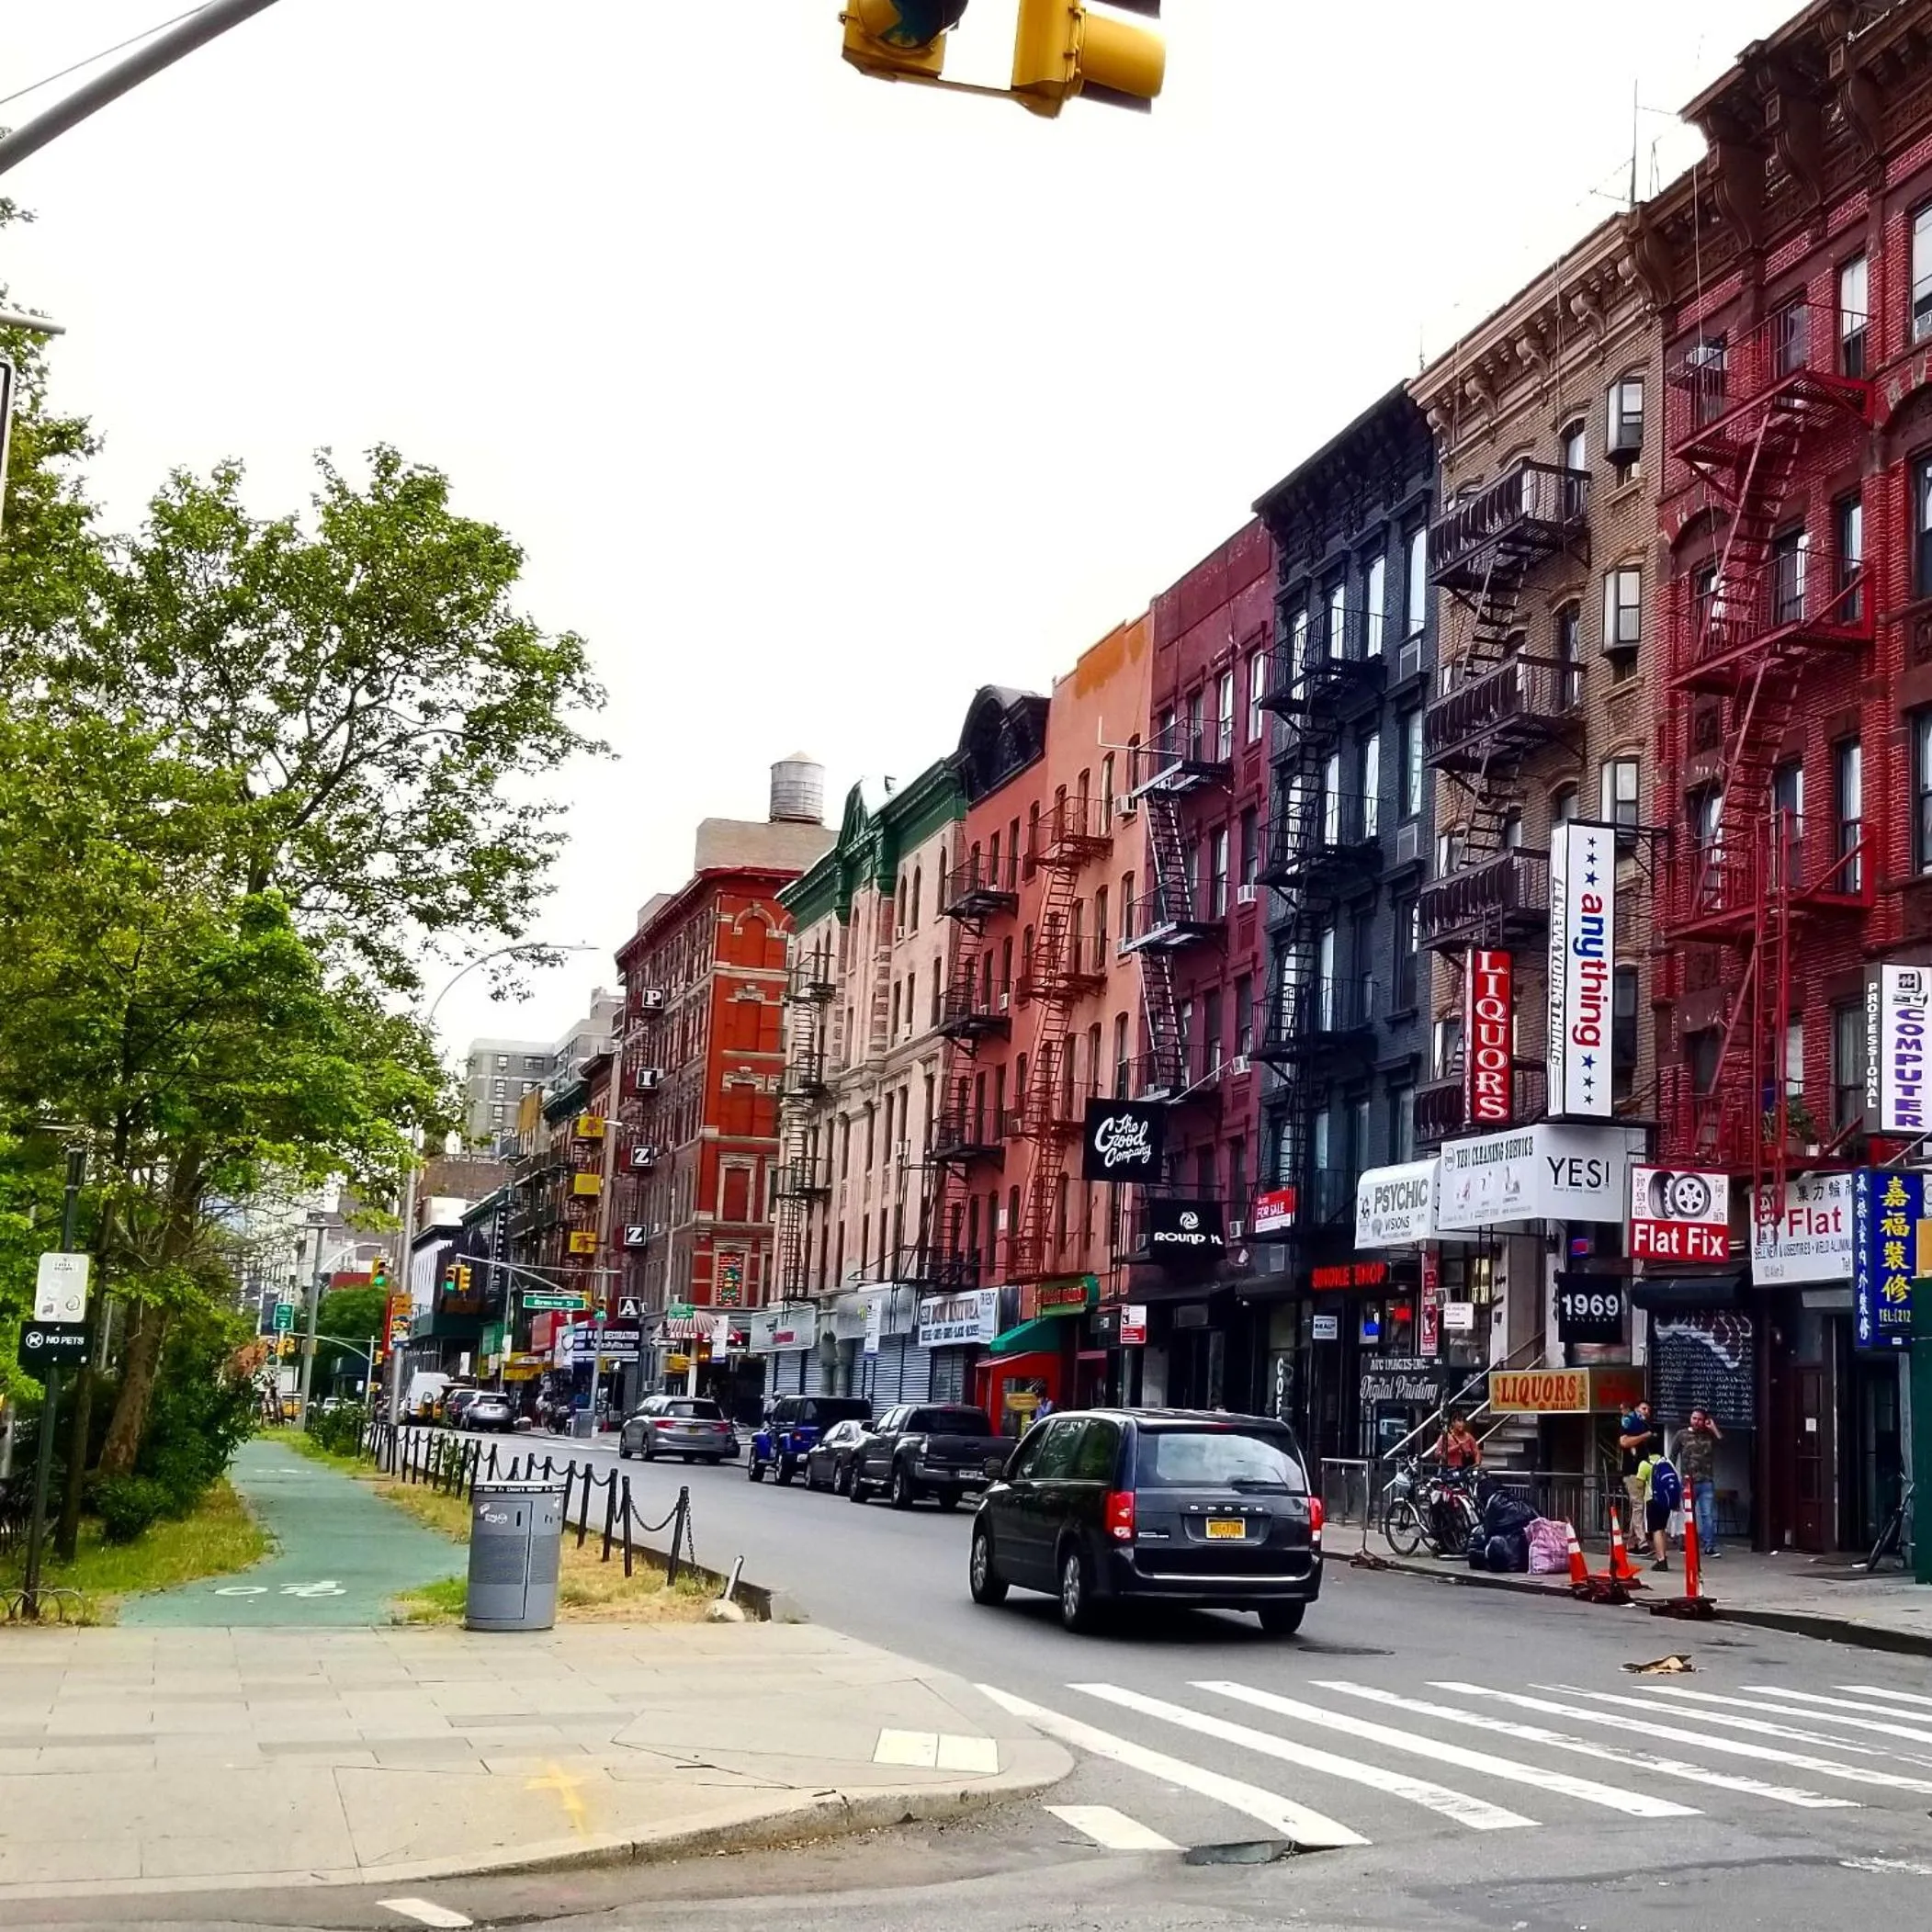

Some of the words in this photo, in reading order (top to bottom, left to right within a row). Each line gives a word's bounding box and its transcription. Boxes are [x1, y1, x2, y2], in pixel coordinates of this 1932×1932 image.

[1573, 893, 1609, 1047] anything
[1475, 951, 1508, 1119] LIQUORS
[1866, 982, 1878, 1109] PROFESSIONAL
[1894, 1008, 1925, 1127] COMPUTER
[1094, 1117, 1148, 1152] Good
[1114, 1113, 1139, 1134] The
[1104, 1145, 1152, 1168] Company
[1546, 1156, 1610, 1189] YES!
[1373, 1179, 1429, 1214] PSYCHIC
[1384, 1215, 1409, 1231] VISIONS
[1788, 1204, 1842, 1237] Flat
[1633, 1223, 1679, 1254] Flat
[1687, 1226, 1724, 1257] Fix
[1879, 1176, 1912, 1304] 嘉福裝修
[1354, 1262, 1385, 1285] SHOP
[1561, 1294, 1619, 1316] 1969
[45, 1335, 59, 1345] NO
[60, 1336, 85, 1346] PETS
[1360, 1374, 1395, 1405] Digital
[1395, 1374, 1439, 1406] Printing
[1500, 1375, 1576, 1407] LIQUORS
